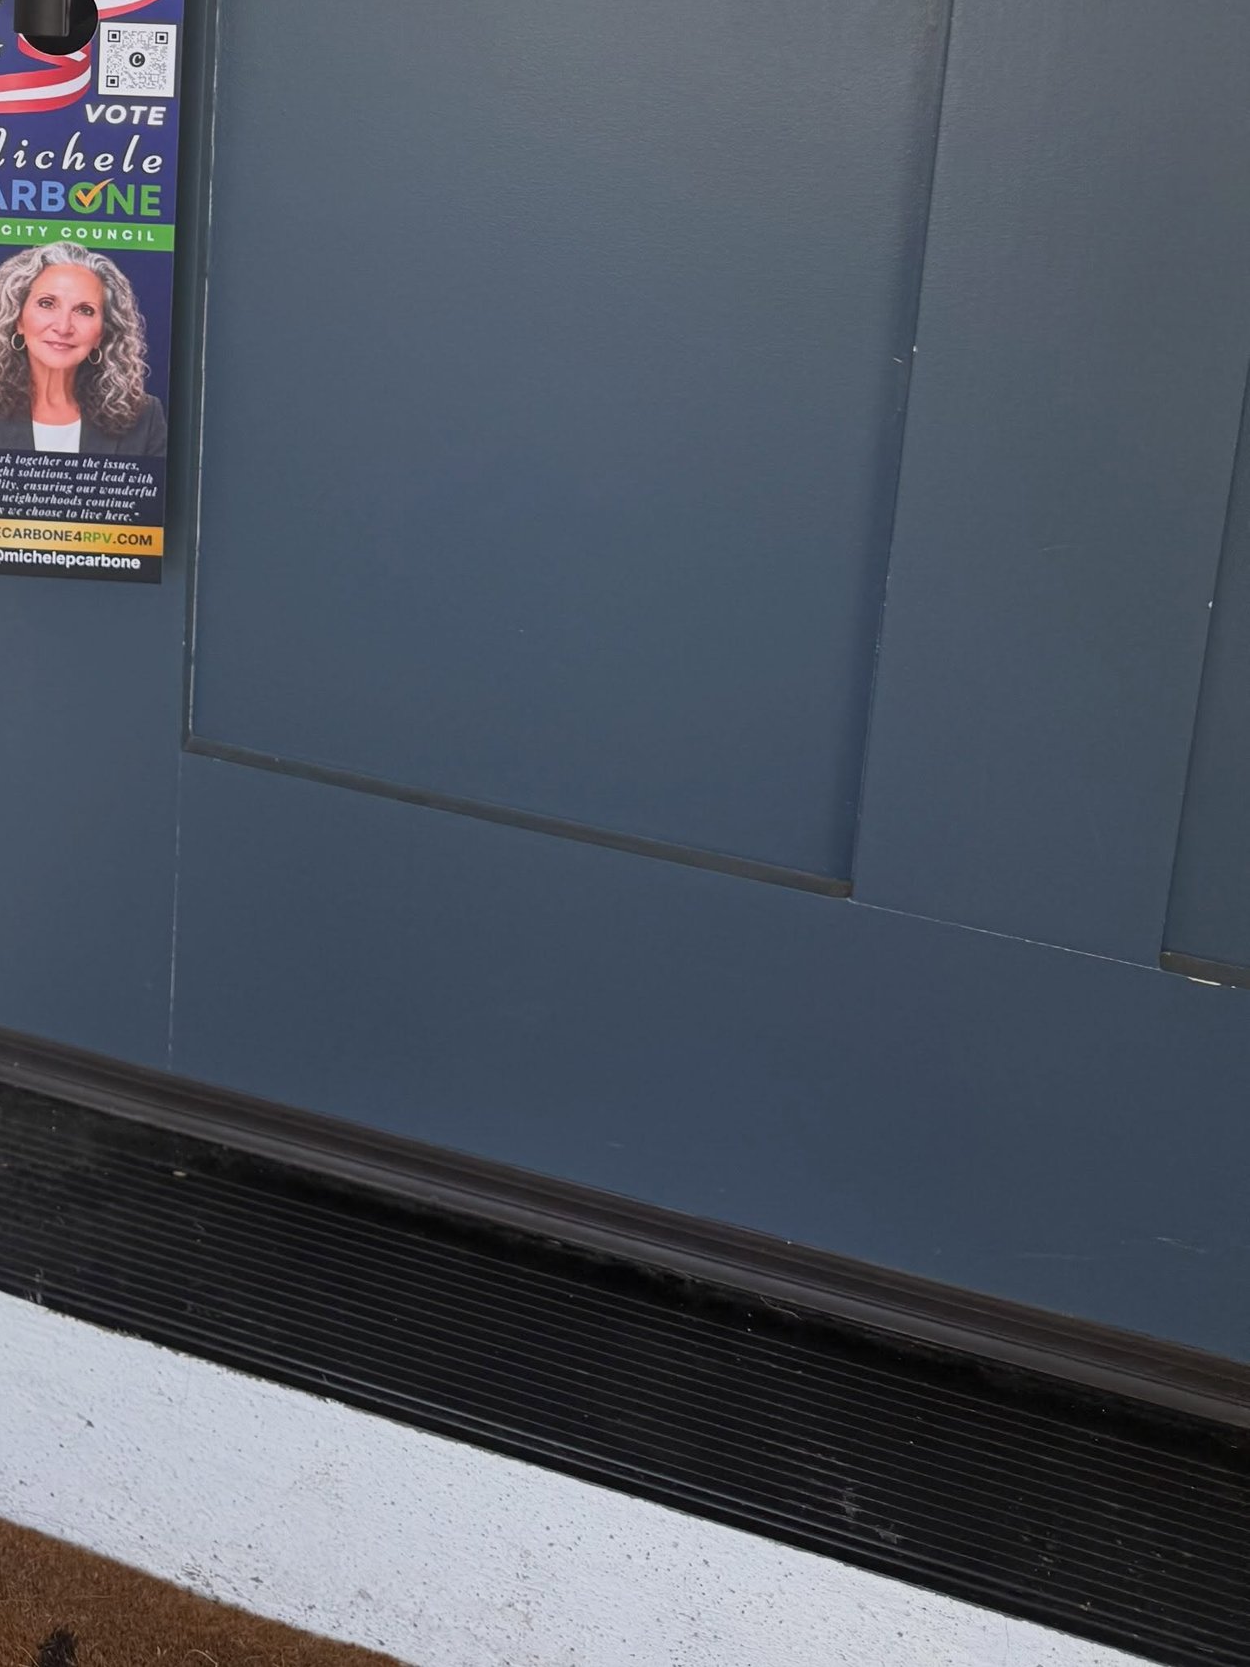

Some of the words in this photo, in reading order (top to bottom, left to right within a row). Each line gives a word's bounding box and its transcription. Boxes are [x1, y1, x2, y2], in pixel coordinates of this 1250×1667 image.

[85, 104, 167, 126] VOTE
[1, 224, 49, 238] CITY
[61, 227, 155, 242] COUNCIL
[15, 454, 62, 467] together
[64, 458, 79, 468] on
[82, 457, 100, 468] the
[75, 470, 98, 481] and
[101, 471, 126, 483] lead
[128, 473, 154, 485] with
[23, 481, 74, 494] ensuring
[76, 485, 96, 494] our
[99, 485, 158, 498] wonderful
[1, 492, 82, 506] neighborhoods
[85, 497, 136, 509] continue
[7, 508, 23, 516] we
[25, 506, 62, 518] choose
[65, 509, 77, 518] to
[80, 508, 102, 520] live
